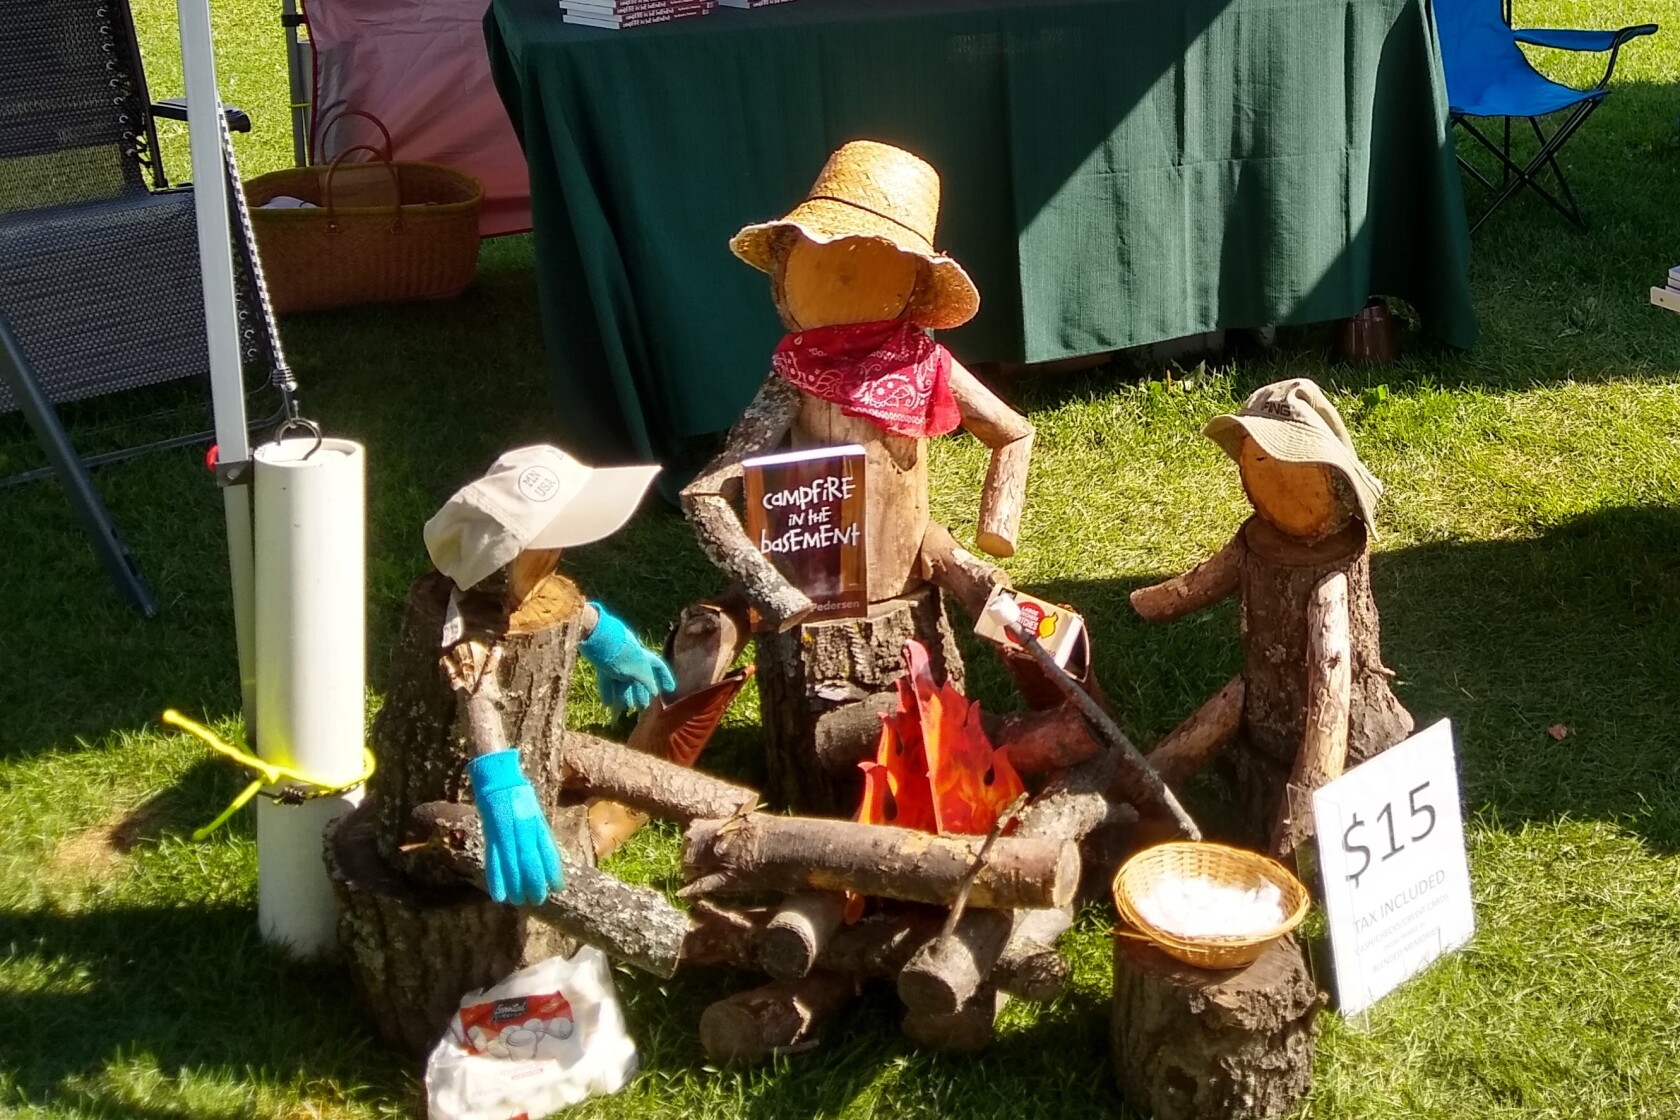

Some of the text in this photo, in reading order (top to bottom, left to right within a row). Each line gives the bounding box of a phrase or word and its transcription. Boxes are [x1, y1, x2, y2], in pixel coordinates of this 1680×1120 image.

[1261, 401, 1291, 417] PING
[534, 478, 556, 497] USA
[810, 600, 860, 612] Pedersen
[1342, 780, 1436, 889] $15
[1352, 869, 1445, 934] TAX INCLUDED
